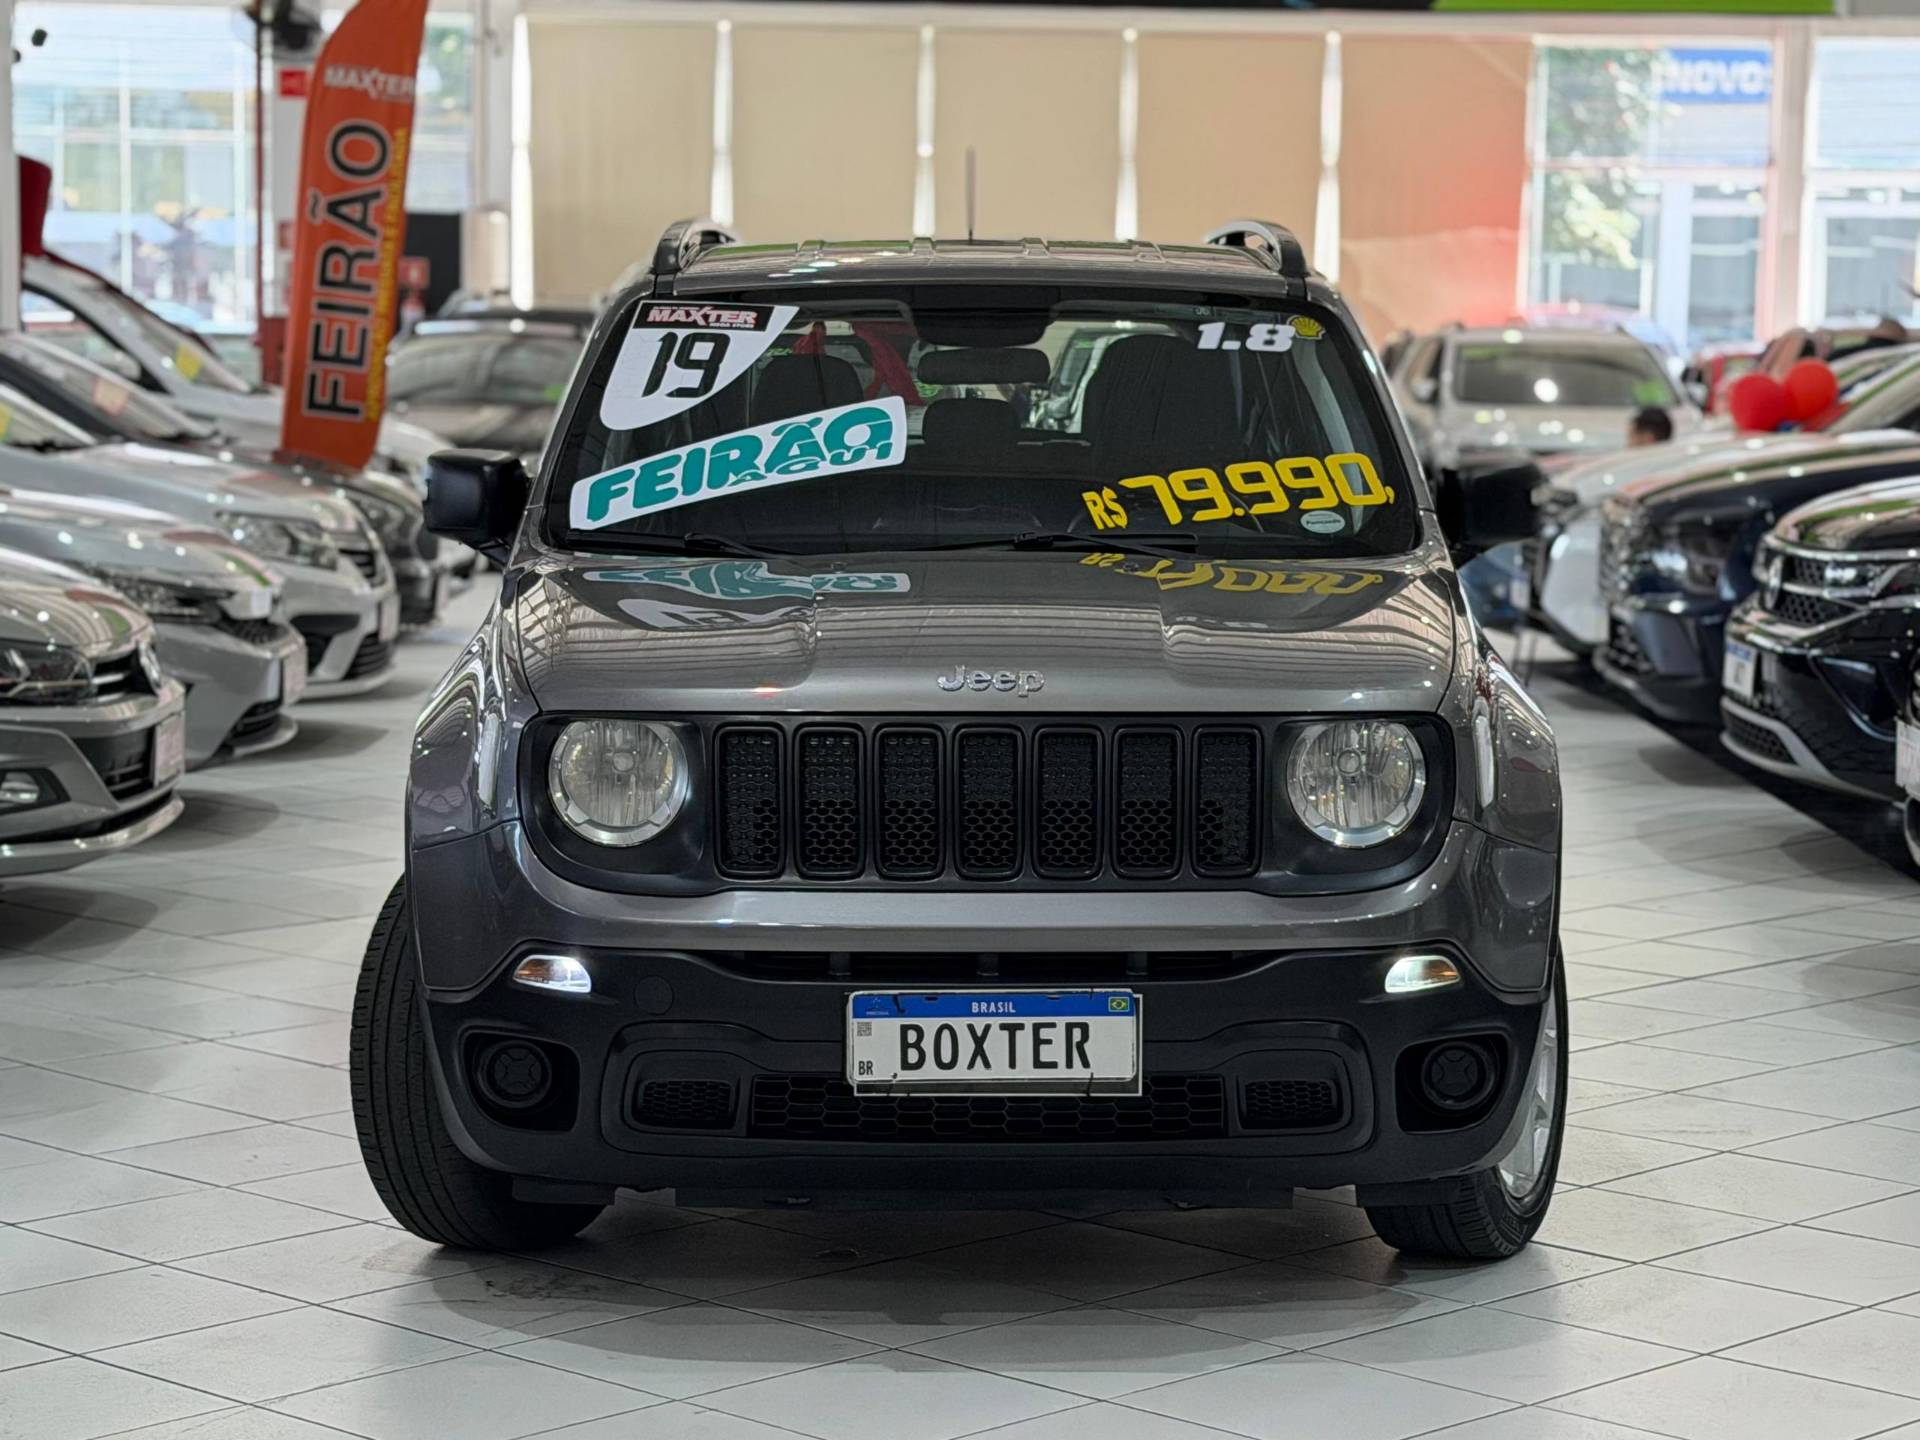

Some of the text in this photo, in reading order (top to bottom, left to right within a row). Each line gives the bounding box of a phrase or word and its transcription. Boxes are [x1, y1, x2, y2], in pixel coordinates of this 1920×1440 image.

[304, 118, 392, 422] FEIRÃO
[646, 305, 758, 326] MAXTER
[1197, 321, 1296, 352] 1.8
[641, 331, 731, 398] 19
[587, 406, 894, 521] FEIRÃO
[1082, 486, 1128, 530] R$
[937, 664, 1045, 698] Jeep
[971, 1001, 1016, 1013] BRASIL
[900, 1021, 1091, 1071] BOXTER
[858, 1060, 873, 1075] BR
